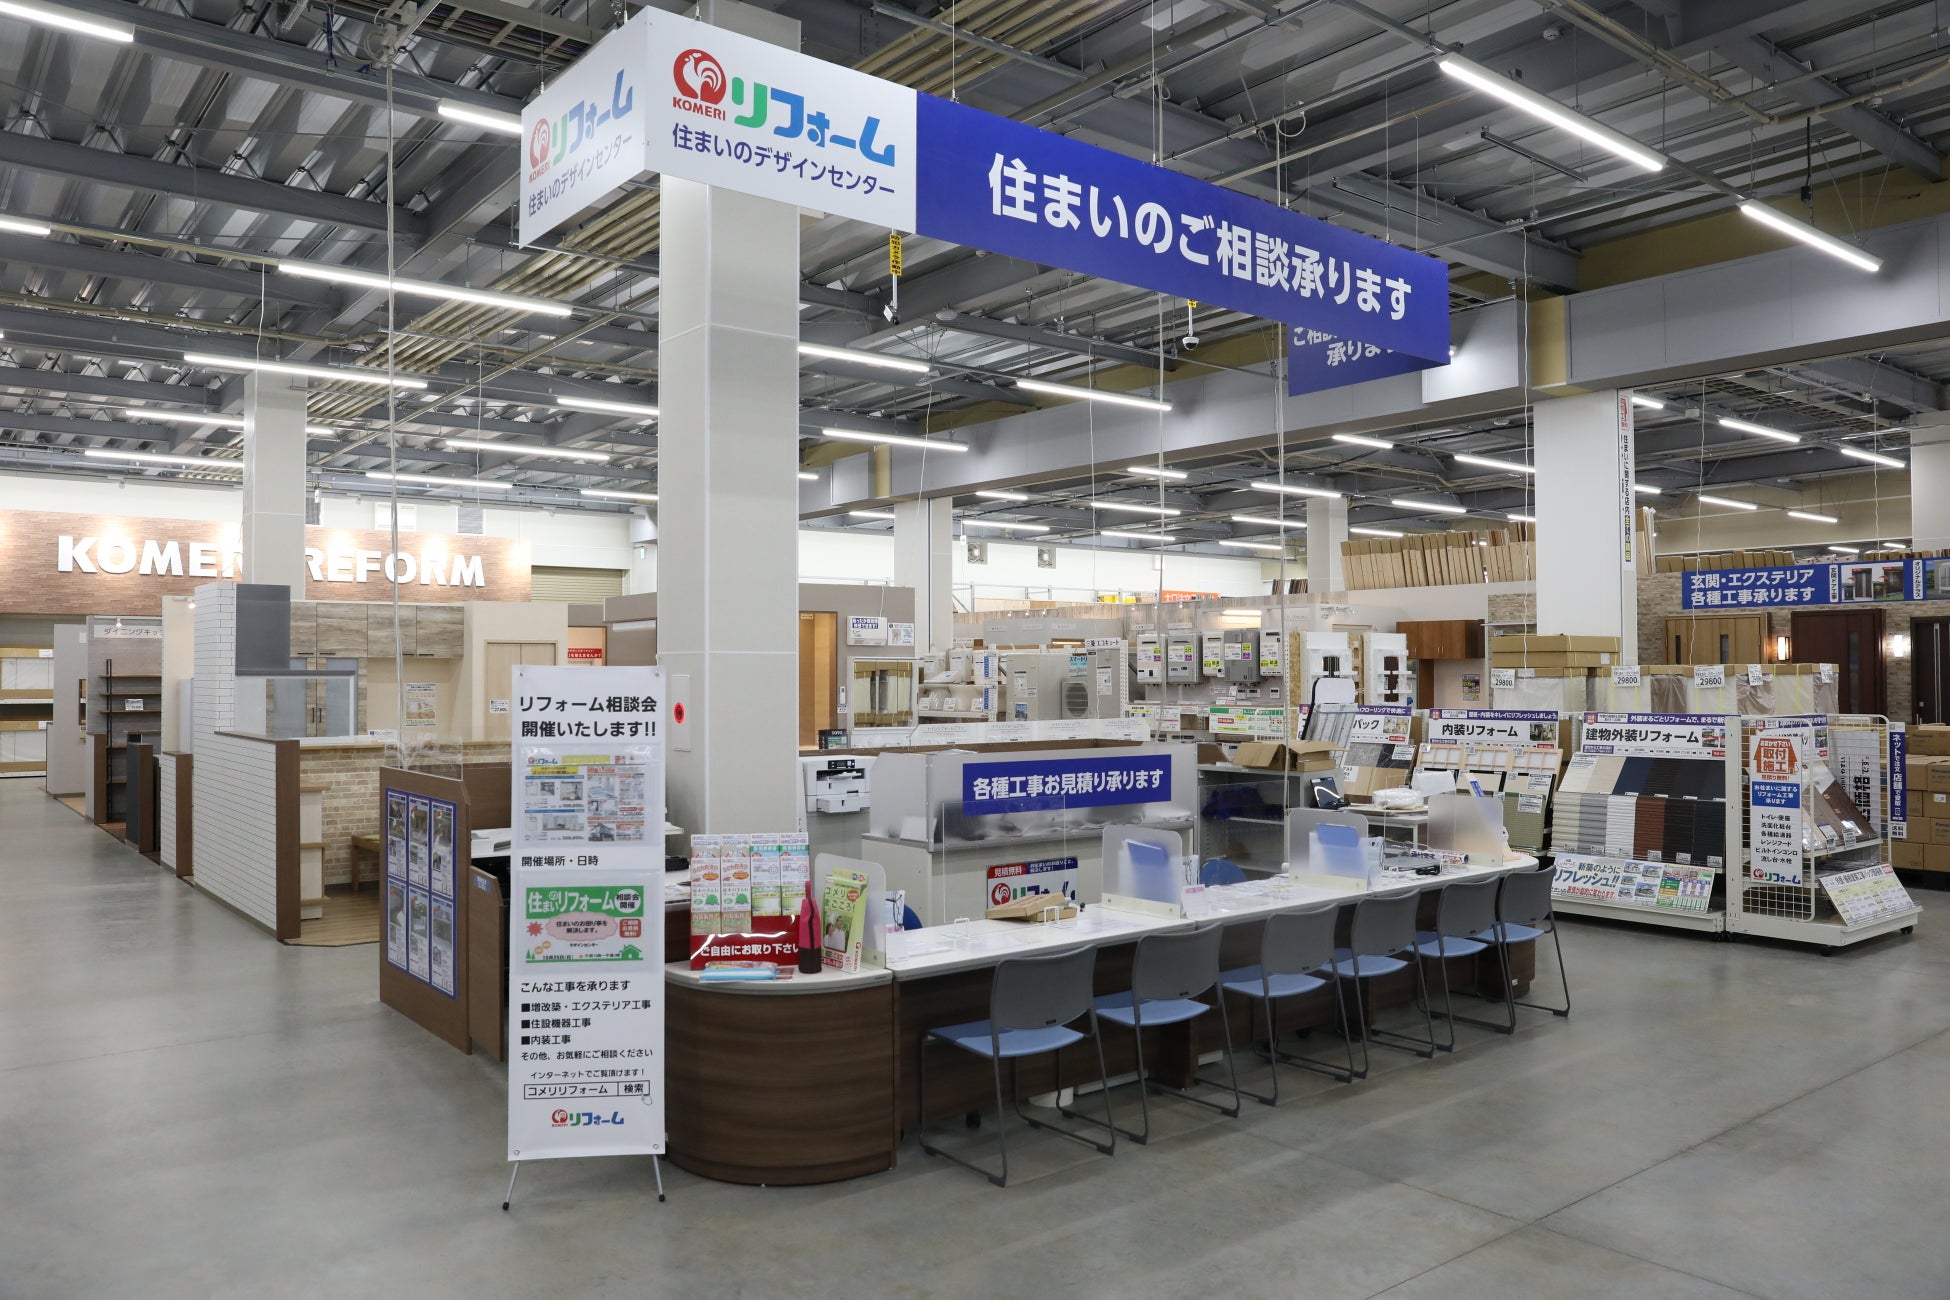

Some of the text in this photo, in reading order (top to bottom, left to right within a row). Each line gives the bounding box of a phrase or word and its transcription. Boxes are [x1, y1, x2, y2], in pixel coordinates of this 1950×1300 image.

[672, 96, 726, 121] KOMERI
[552, 69, 633, 166] リフォーム
[731, 76, 896, 168] リフォーム
[672, 122, 895, 195] 住まいのデザインセンター
[528, 134, 632, 217] 住まいのデザインセンター
[988, 151, 1412, 322] 住まいのご相談承ります
[1690, 568, 1815, 589] 玄関・エクステリア
[1690, 586, 1816, 607] 各種工事承ります
[519, 696, 658, 712] リフォーム相談会
[521, 720, 656, 738] 開催いたします!!
[1442, 723, 1519, 737] 内装リフォーム
[1585, 727, 1700, 743] 建物外装リフォーム
[1763, 748, 1787, 760] 取付
[1763, 760, 1787, 772] 施工
[972, 768, 1164, 801] 各種工事お見積り承ります
[1761, 839, 1792, 847] レンジフード
[1755, 847, 1798, 856] ビルトインコンロ
[521, 855, 599, 867] 開催場所・日時
[1765, 872, 1801, 885] リフォーム
[616, 893, 639, 901] 相談会
[619, 901, 636, 909] 開催
[521, 980, 631, 993] こんな工事を承ります
[530, 999, 652, 1013] 増改築・エクステリア工事
[530, 1017, 592, 1029] 住設機器工事
[530, 1034, 572, 1045] 内装工事
[521, 1049, 653, 1061] その他、お気軽にご相談ください
[528, 1083, 644, 1097] コメリリフォーム 検索
[569, 1110, 625, 1127] リフォーム
